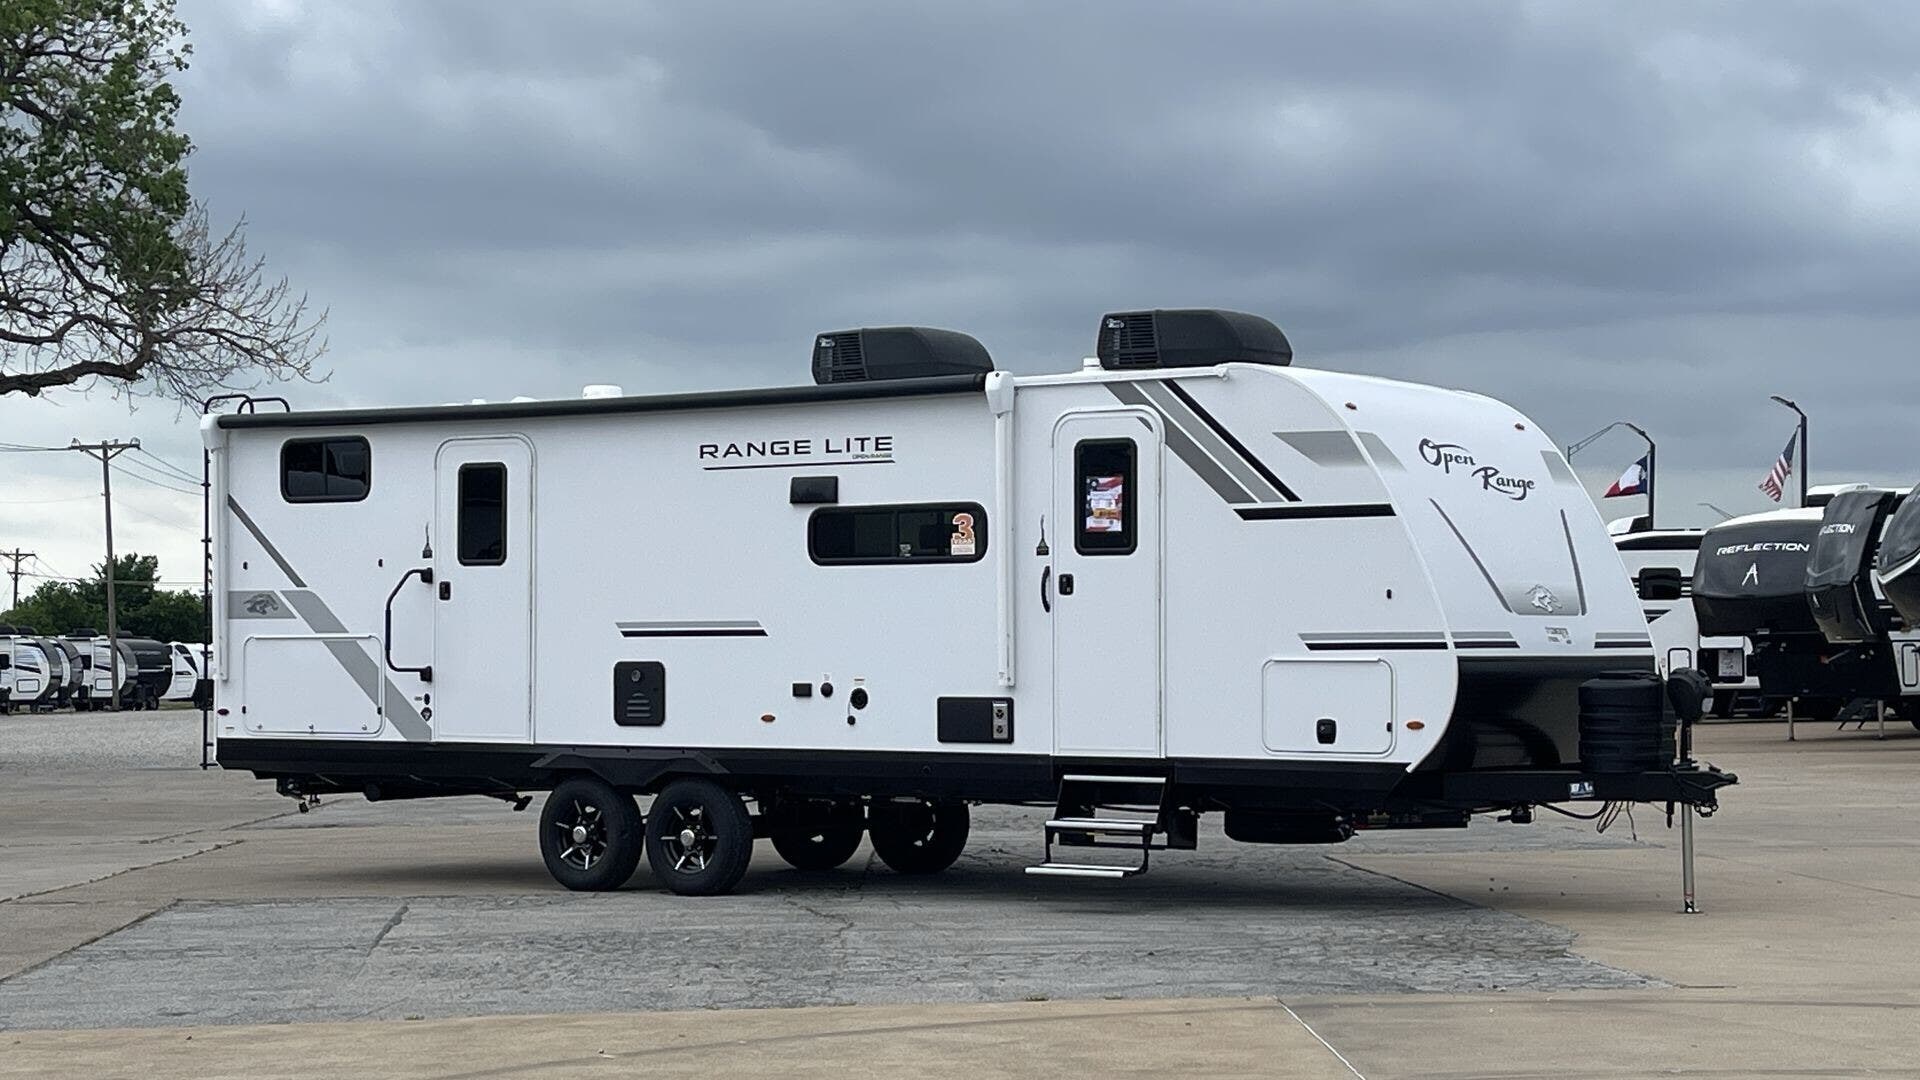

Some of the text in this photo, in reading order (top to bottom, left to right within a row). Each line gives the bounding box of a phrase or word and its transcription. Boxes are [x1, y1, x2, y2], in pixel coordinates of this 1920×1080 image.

[699, 436, 894, 459] RANGE LITE
[1418, 437, 1476, 474] Open
[1471, 466, 1536, 501] Range
[953, 513, 975, 541] 3
[1716, 542, 1810, 556] REFLECTION
